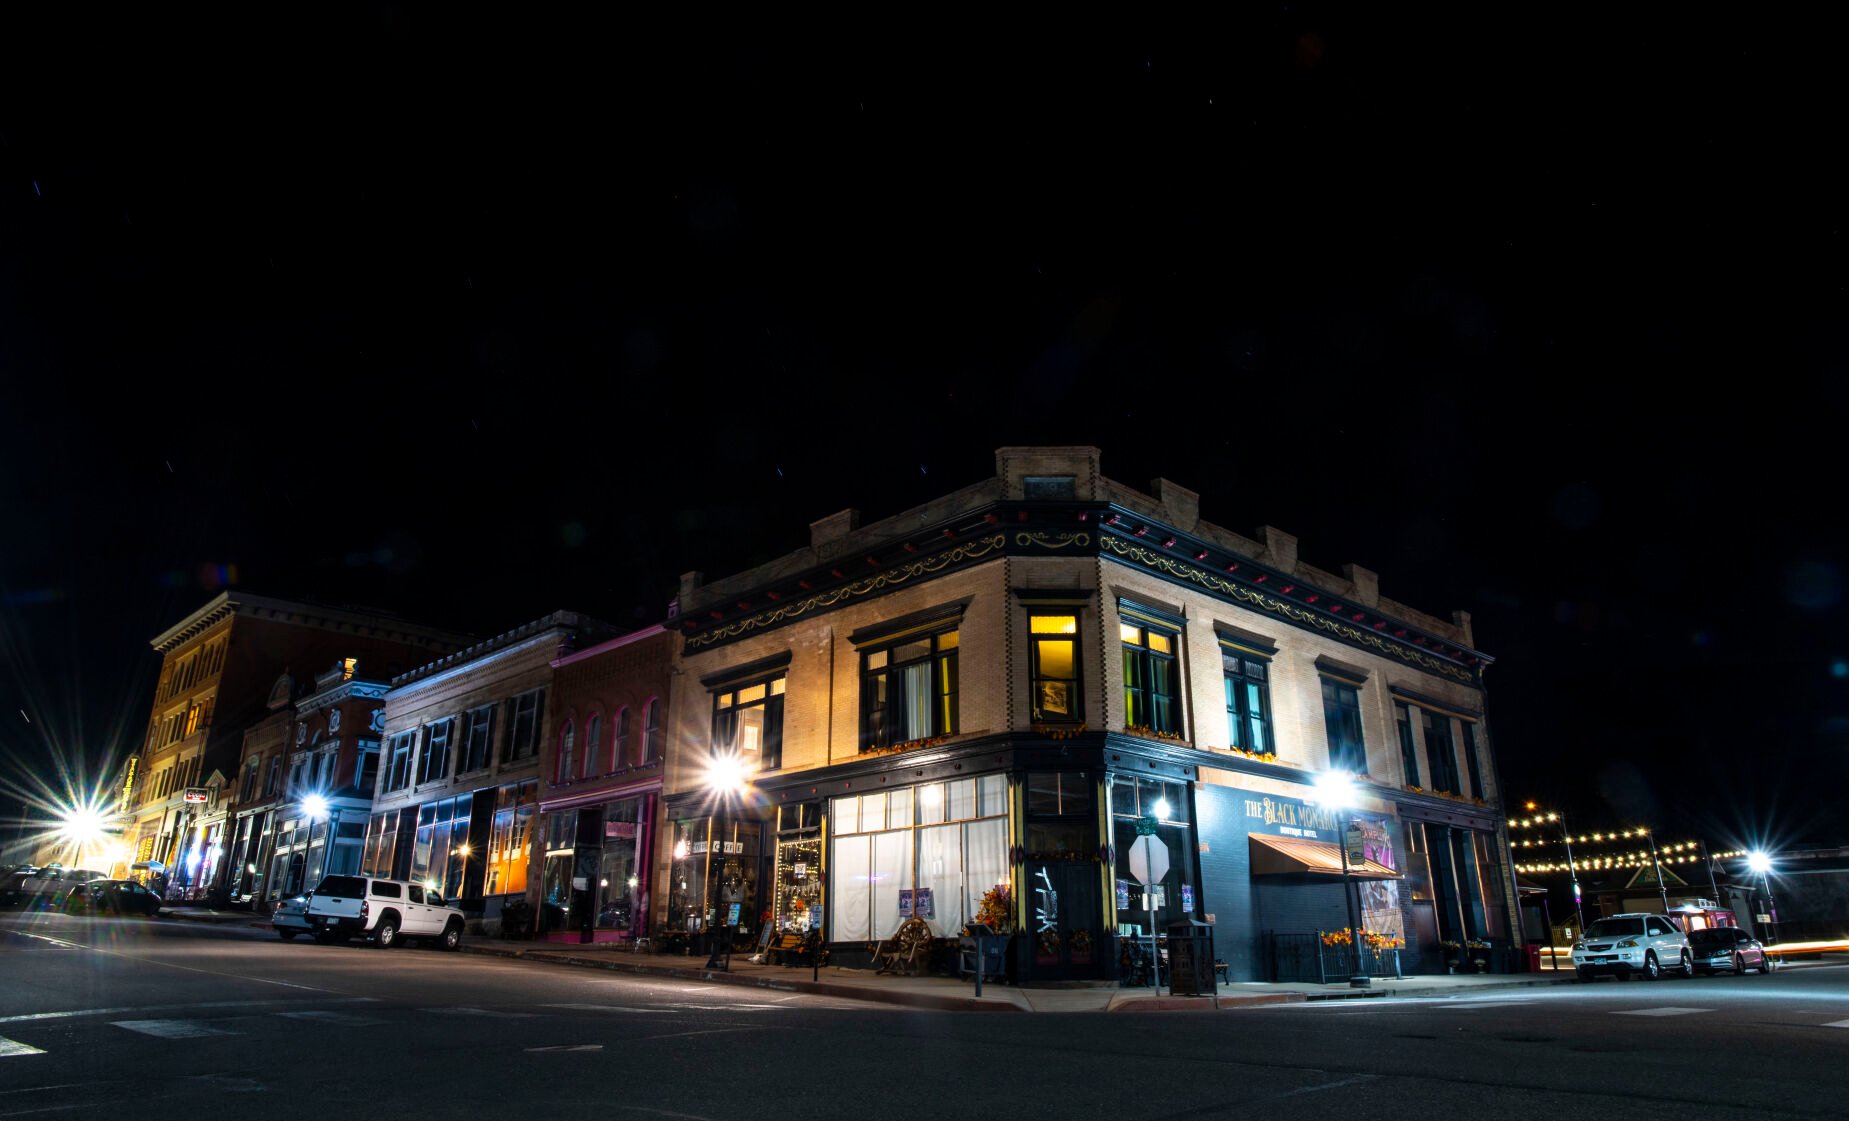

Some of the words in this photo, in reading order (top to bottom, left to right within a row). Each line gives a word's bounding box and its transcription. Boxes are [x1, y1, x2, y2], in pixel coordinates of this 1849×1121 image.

[1245, 800, 1262, 818] THE
[1264, 797, 1297, 825] BLACK
[1298, 807, 1338, 831] MONARC
[715, 842, 742, 852] CFFE
